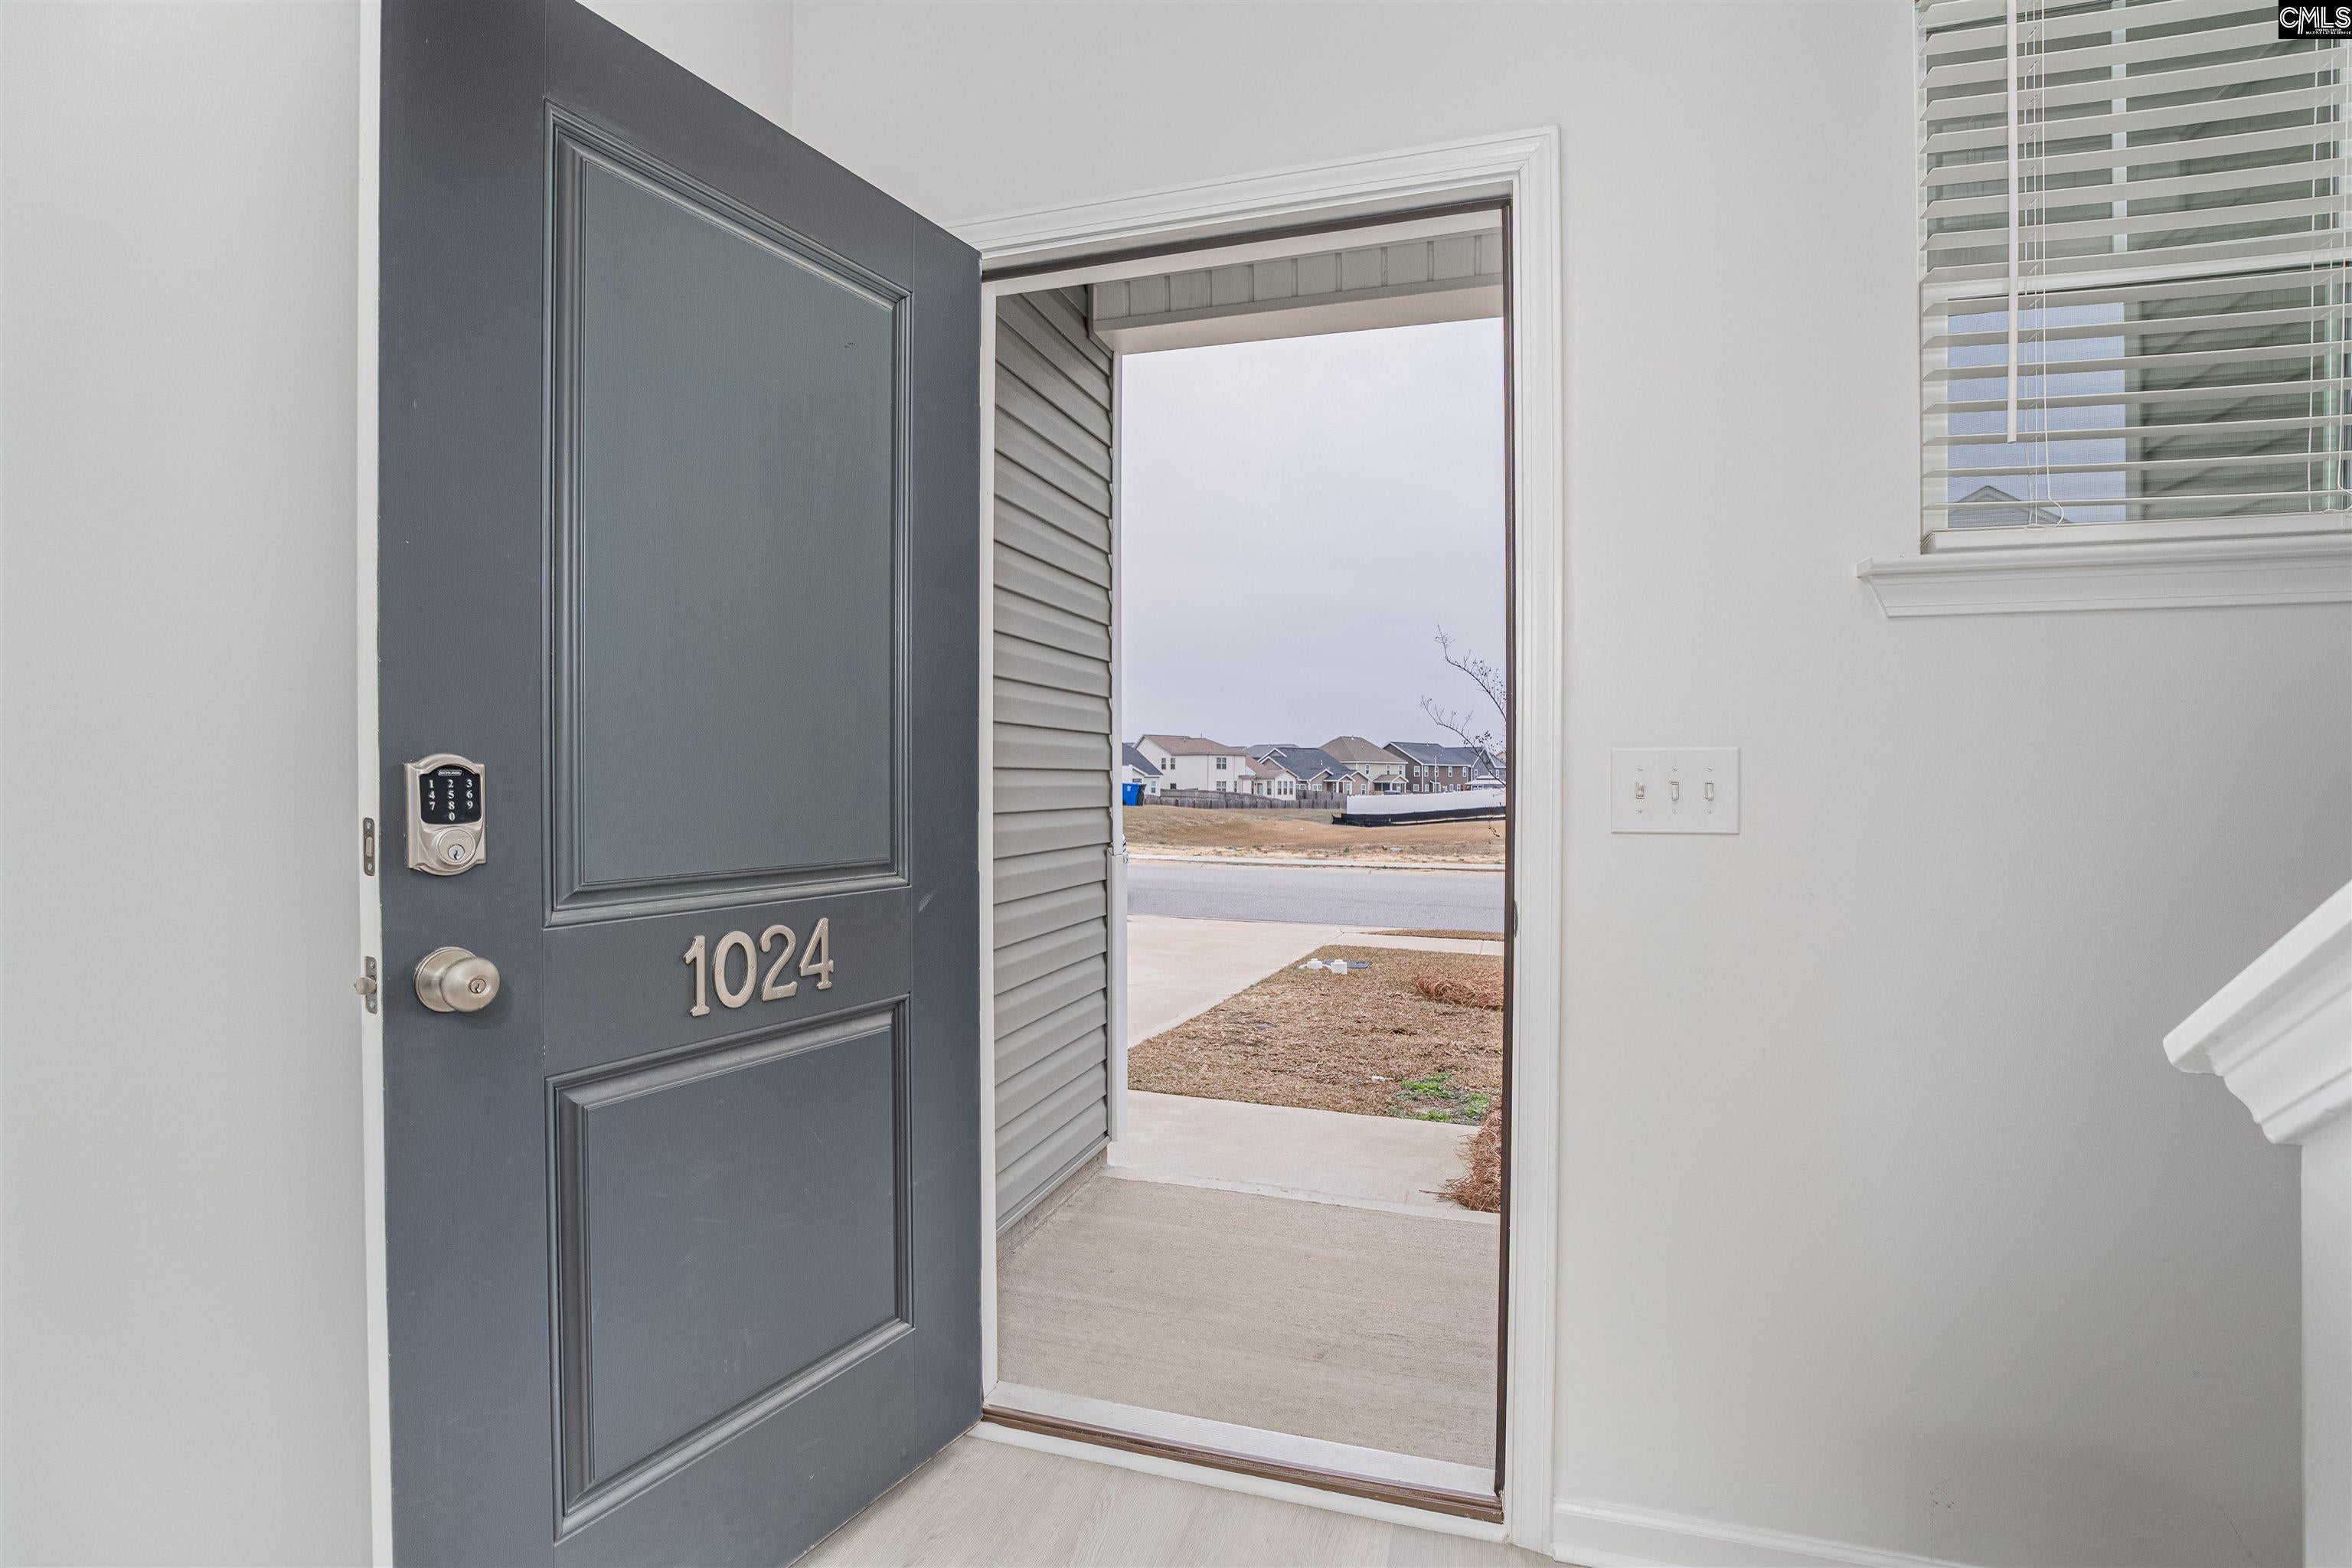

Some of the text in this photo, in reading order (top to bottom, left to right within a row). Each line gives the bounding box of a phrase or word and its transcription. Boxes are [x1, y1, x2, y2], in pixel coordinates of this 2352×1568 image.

[429, 779, 473, 788] 1 2 3
[428, 790, 473, 799] 4 5 6
[429, 801, 474, 811] 7 8 9
[449, 812, 456, 821] 0
[683, 917, 835, 1017] 1024
